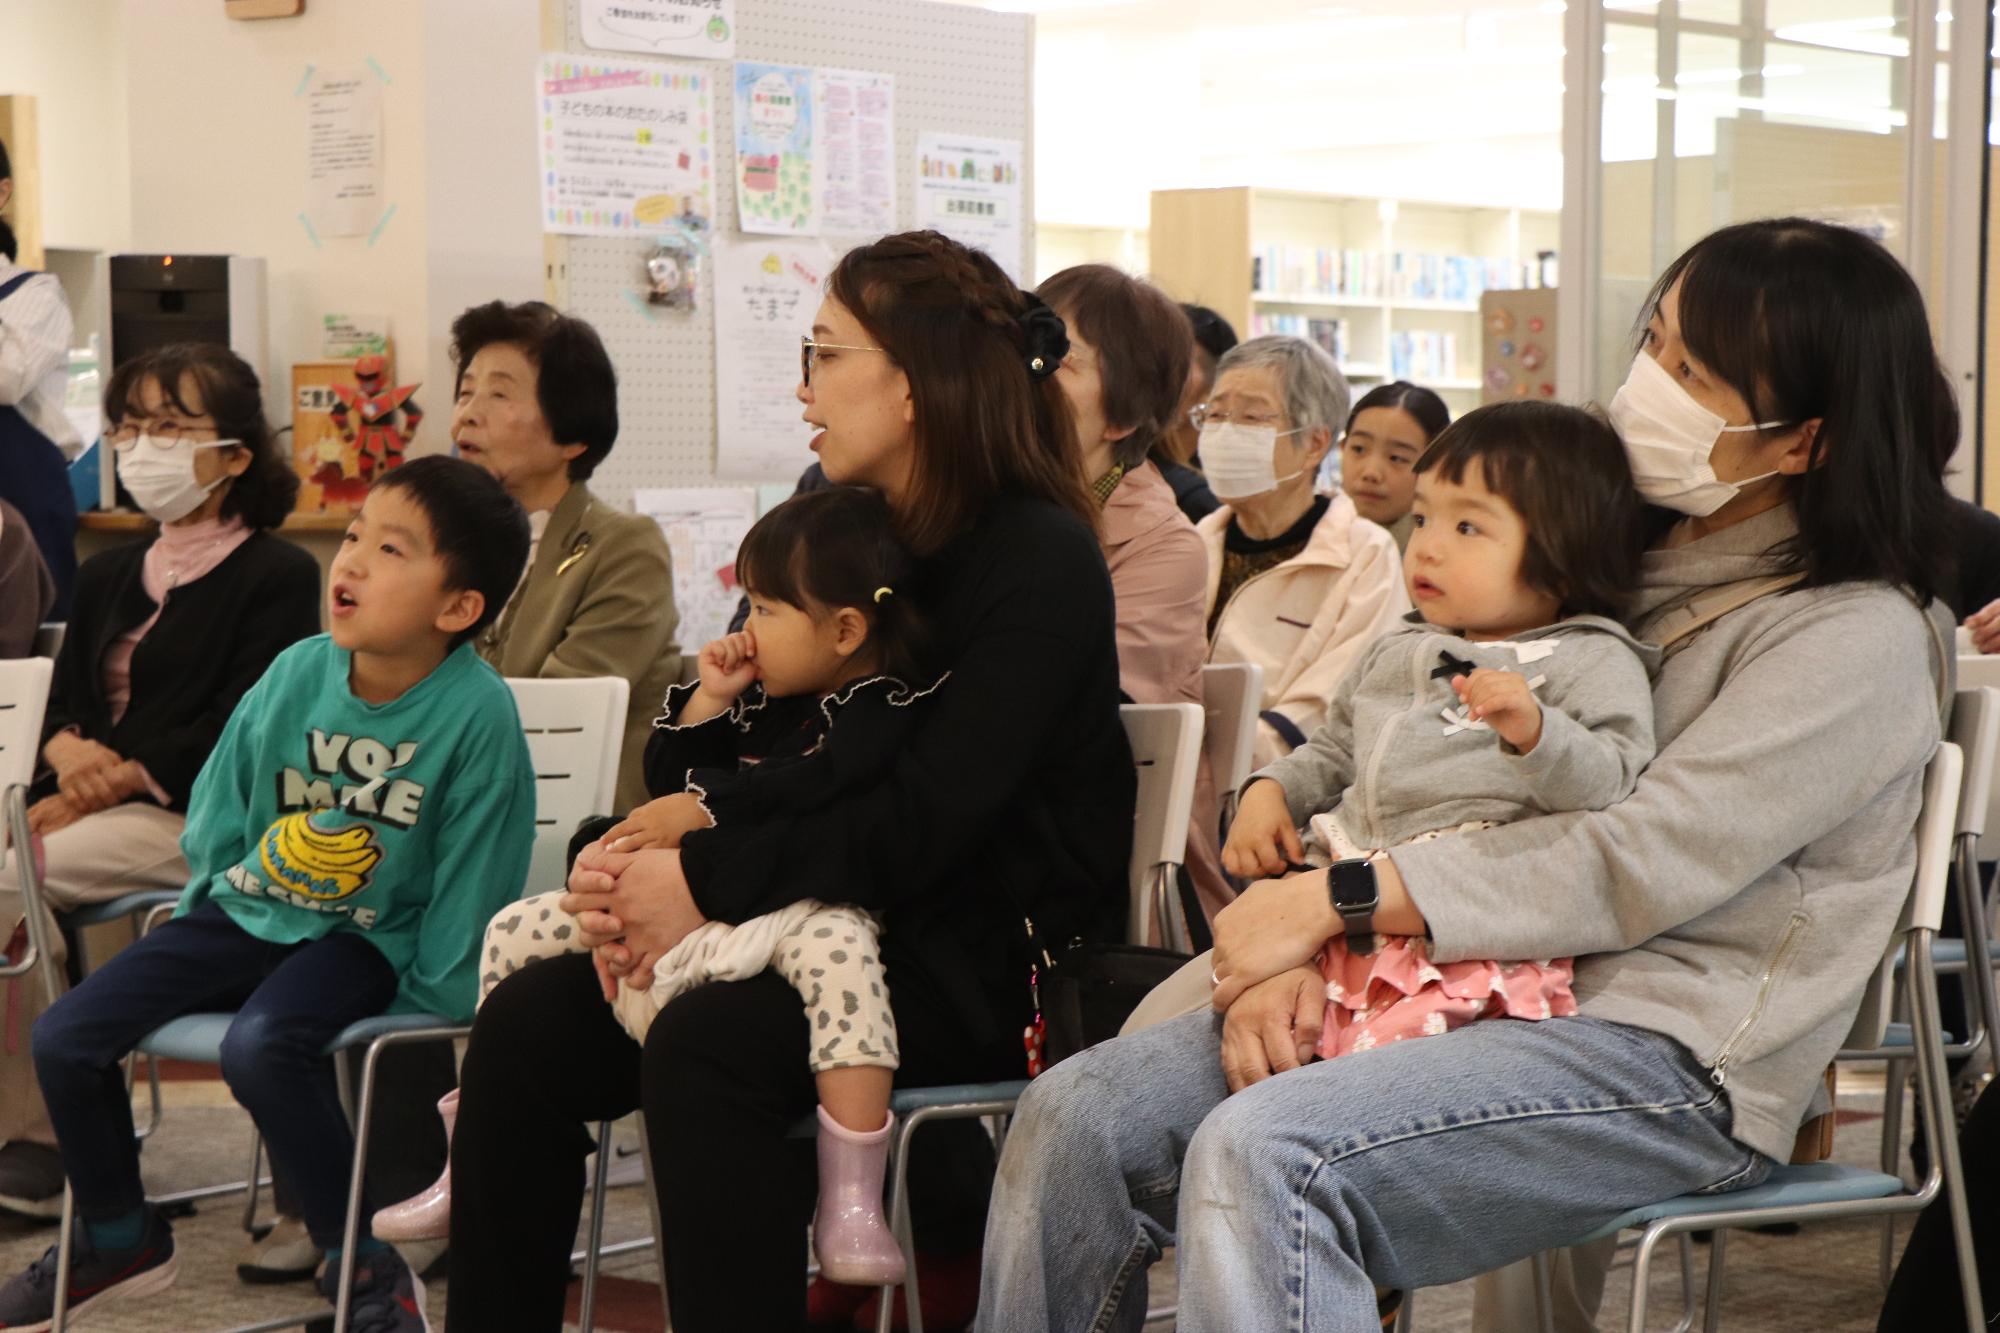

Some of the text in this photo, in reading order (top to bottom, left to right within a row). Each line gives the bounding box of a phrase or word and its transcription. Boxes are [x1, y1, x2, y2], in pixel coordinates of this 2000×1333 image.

[946, 199, 996, 216] 出張図書館
